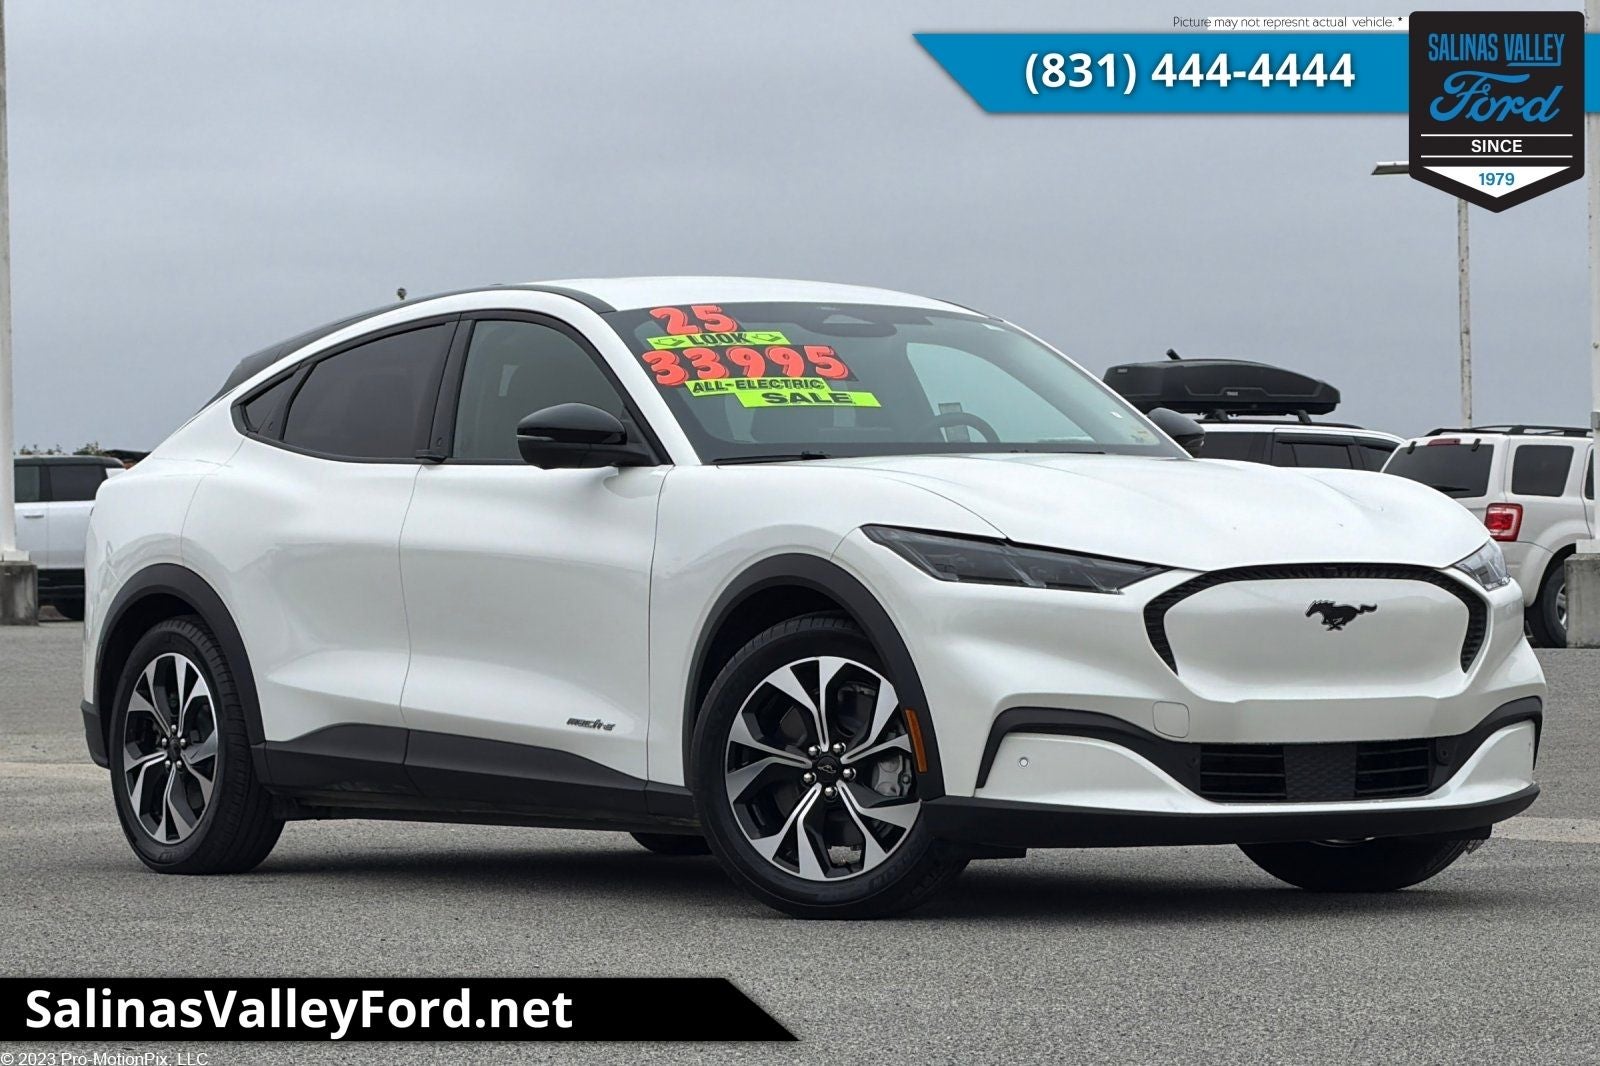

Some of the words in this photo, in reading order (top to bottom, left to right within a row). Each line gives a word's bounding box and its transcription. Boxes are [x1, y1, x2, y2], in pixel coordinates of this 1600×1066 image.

[649, 304, 738, 335] 25
[685, 332, 752, 346] LOOK
[642, 346, 849, 386] 33995
[693, 379, 824, 393] ALL-ELECTRIC
[762, 392, 853, 405] SALE
